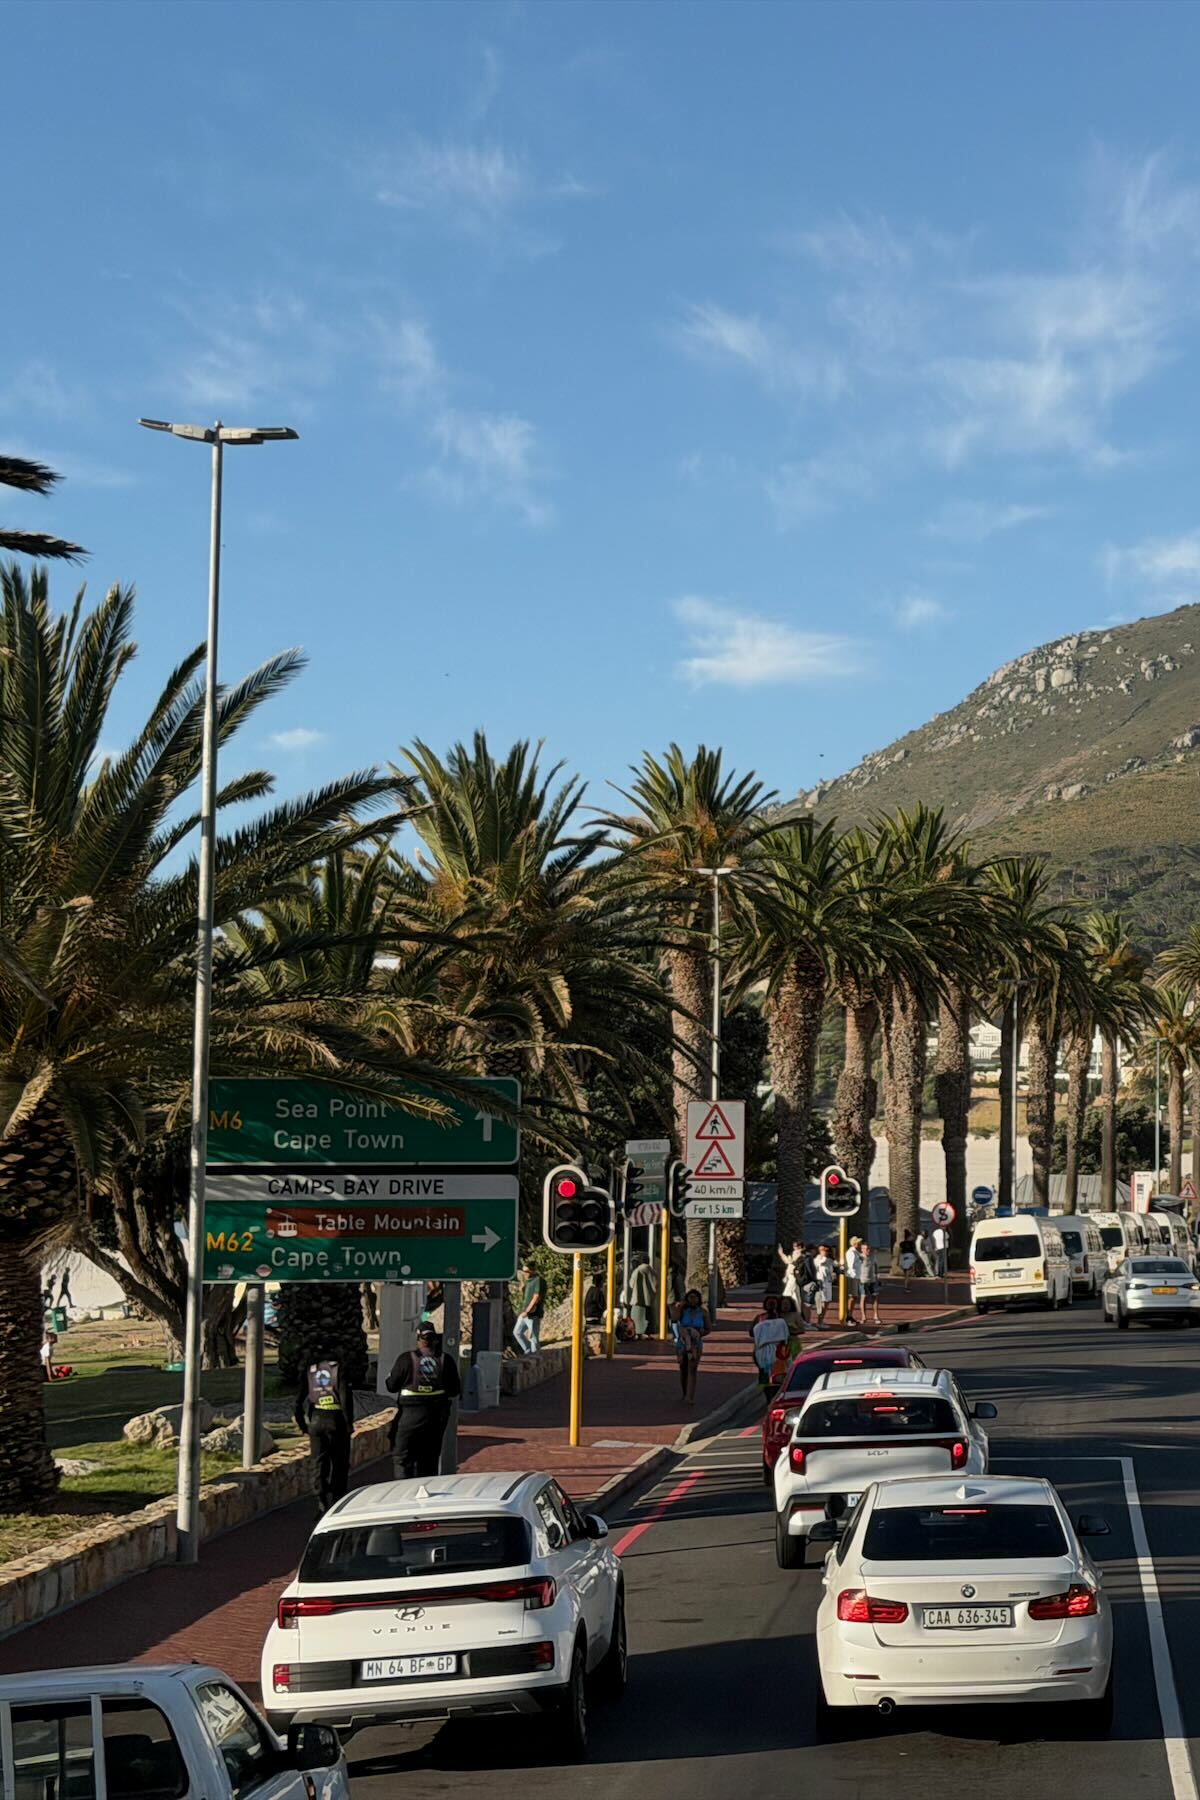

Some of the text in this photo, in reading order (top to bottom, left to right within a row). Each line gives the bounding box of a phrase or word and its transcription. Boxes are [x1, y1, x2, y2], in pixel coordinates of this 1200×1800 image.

[275, 1098, 388, 1118] Sea Point
[209, 1110, 243, 1130] M6
[273, 1129, 404, 1154] Cape Town
[268, 1179, 444, 1195] CAMPS BAY DRIVE
[694, 1184, 737, 1195] 40 km/h
[693, 1204, 735, 1215] For 1.5 km
[315, 1214, 460, 1231] Table Mountain
[207, 1231, 254, 1252] M62
[271, 1246, 329, 1271] Cape
[341, 1246, 401, 1266] Town
[928, 1609, 1007, 1625] CAA 636-345
[373, 1623, 451, 1635] VENUE
[367, 1656, 453, 1677] MN 64 BF GP
